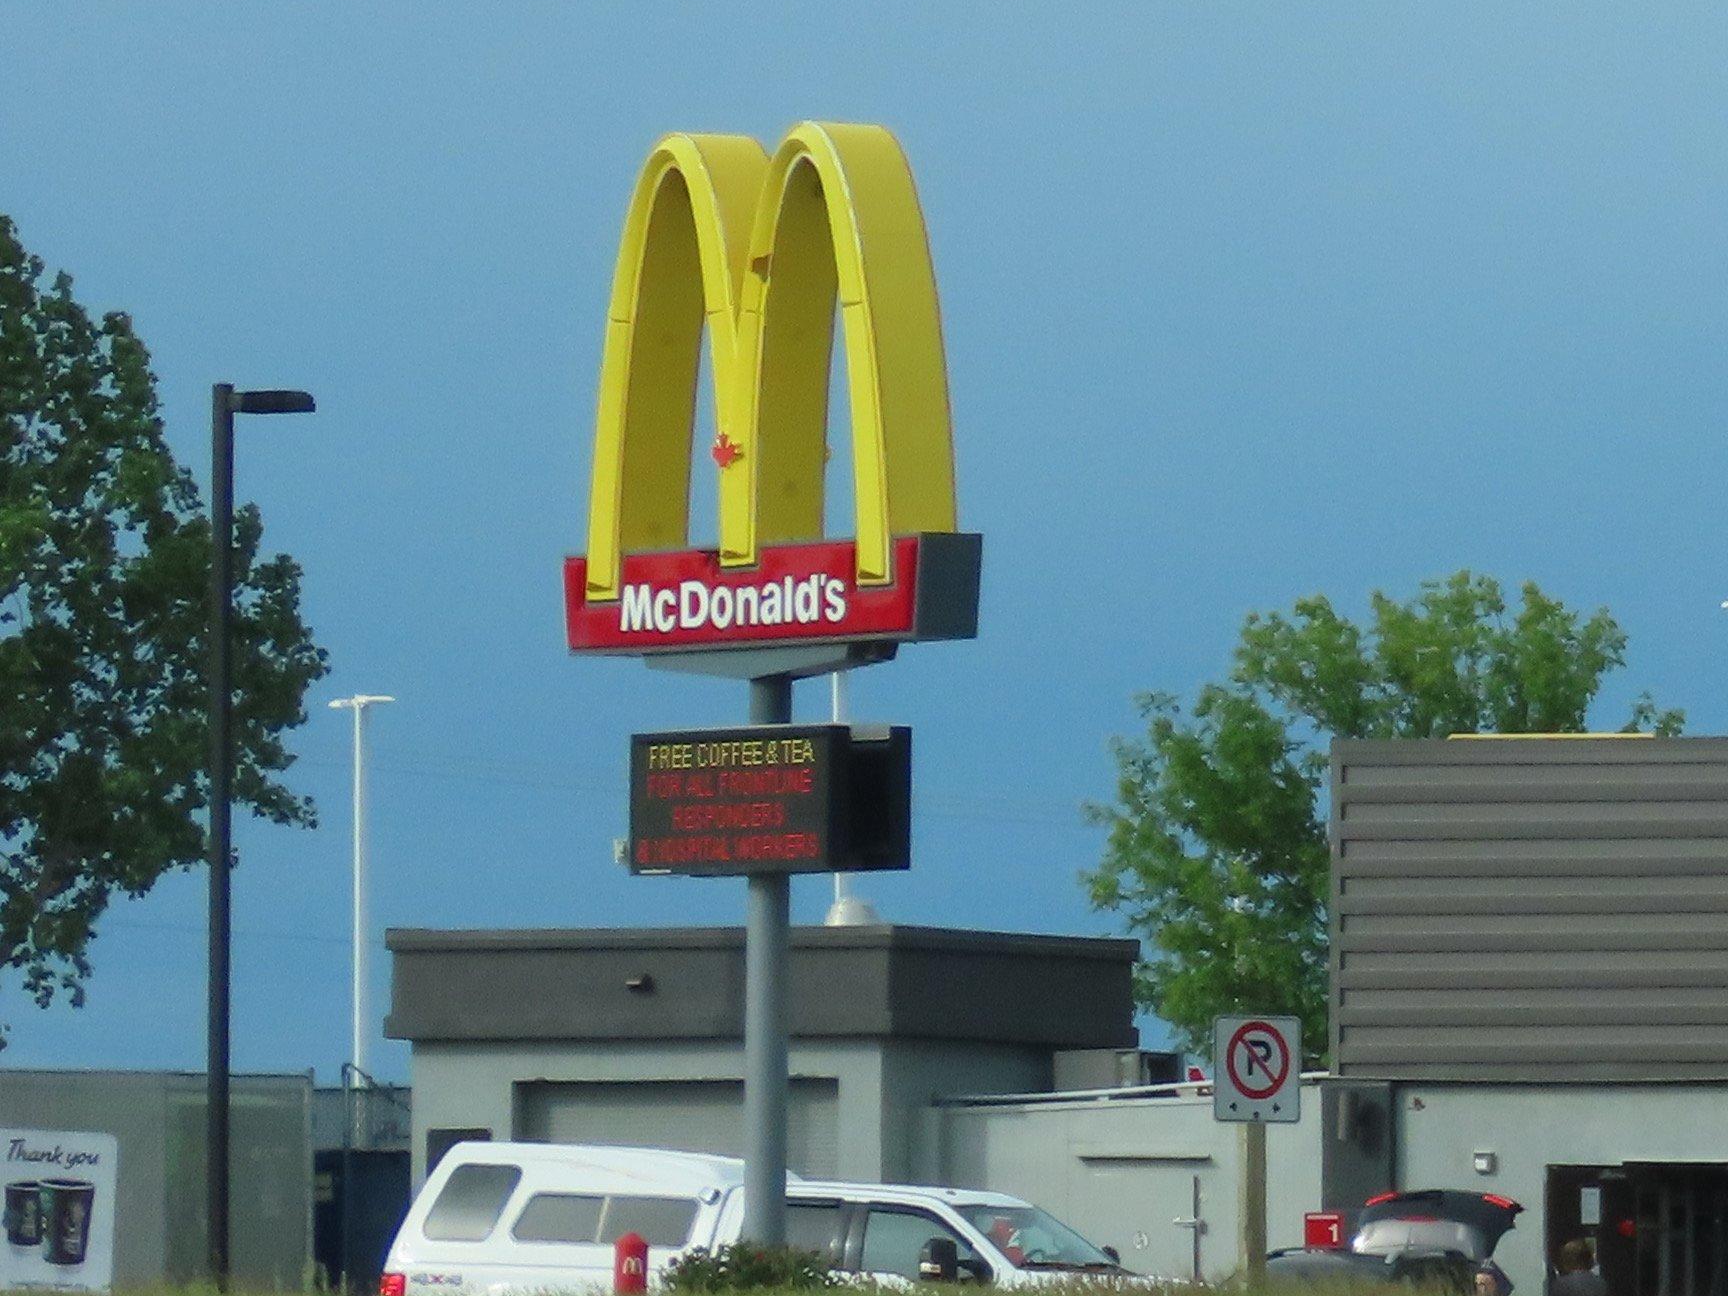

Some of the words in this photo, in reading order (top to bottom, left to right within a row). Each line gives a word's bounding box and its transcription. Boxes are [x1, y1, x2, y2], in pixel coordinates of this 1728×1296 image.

[620, 573, 847, 632] McDonald's
[649, 744, 692, 769] FREE
[697, 741, 763, 768] COFFEE
[767, 740, 779, 764] &
[781, 739, 816, 763] TEA
[8, 1138, 62, 1164] Thank
[66, 1150, 100, 1170] you
[1328, 1223, 1340, 1242] 1
